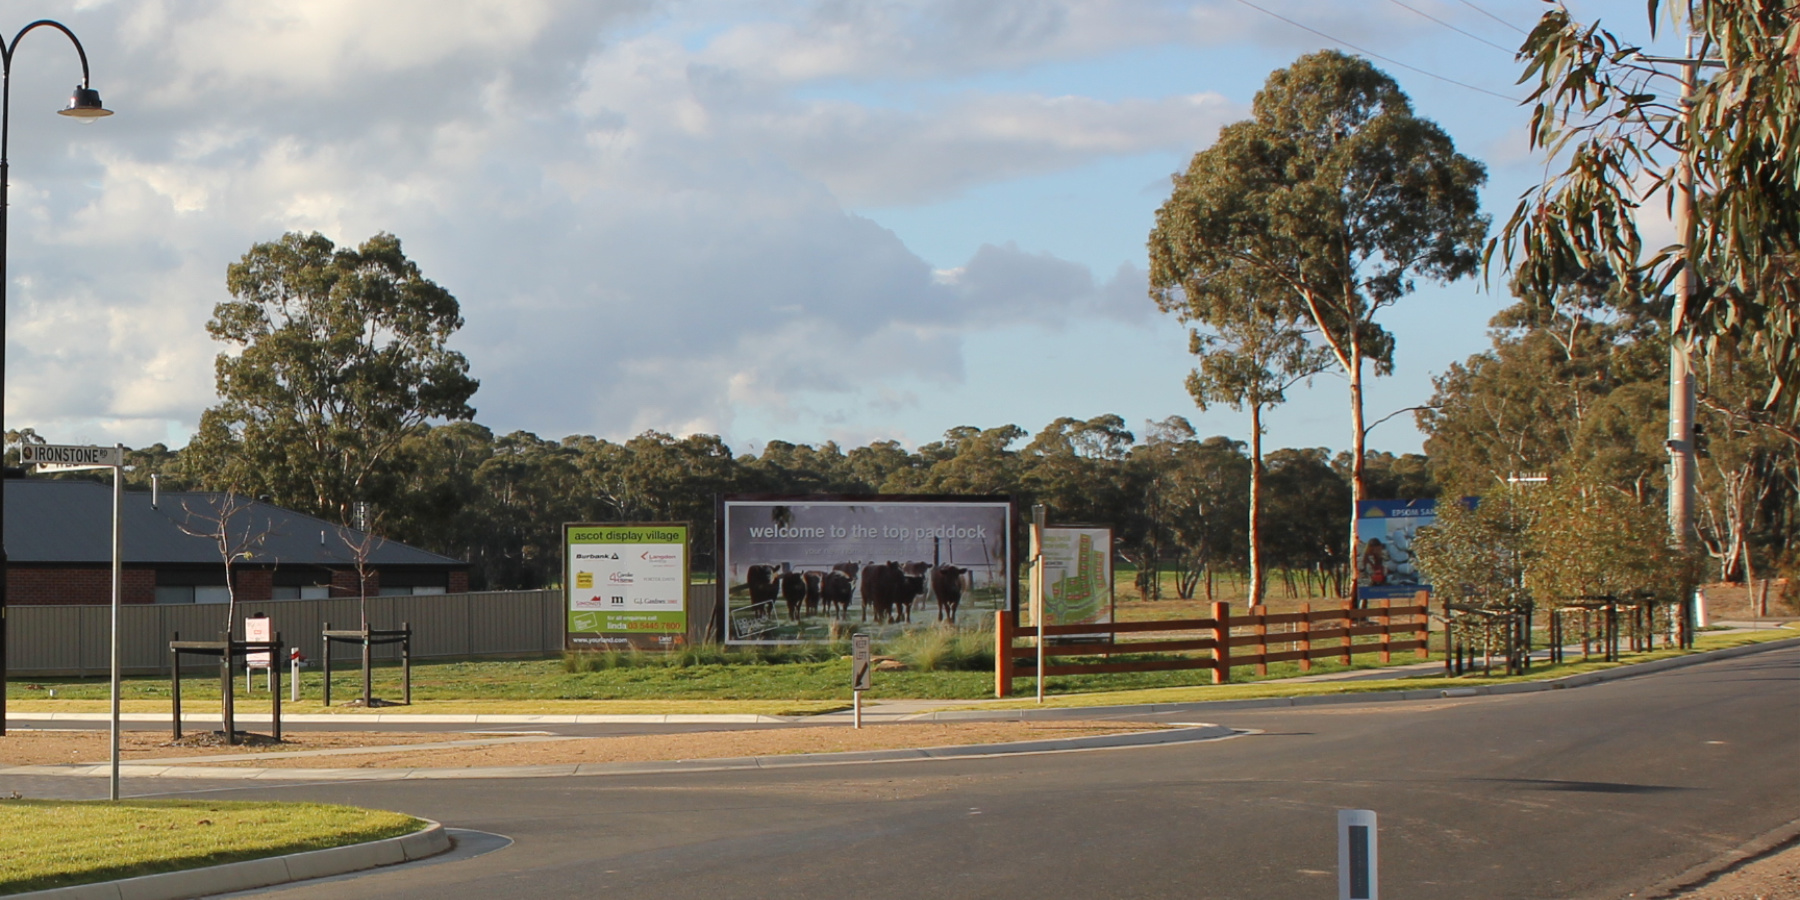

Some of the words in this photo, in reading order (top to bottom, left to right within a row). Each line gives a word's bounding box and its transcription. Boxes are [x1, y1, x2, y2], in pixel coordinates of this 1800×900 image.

[35, 446, 99, 463] IRONSTONE
[1391, 509, 1419, 517] EPSOM
[574, 531, 603, 540] ascot
[606, 531, 643, 542] display
[646, 531, 680, 542] village
[750, 524, 825, 539] welcome
[830, 525, 847, 538] to
[851, 524, 878, 538] the
[883, 525, 910, 541] top
[915, 524, 987, 541] paddock
